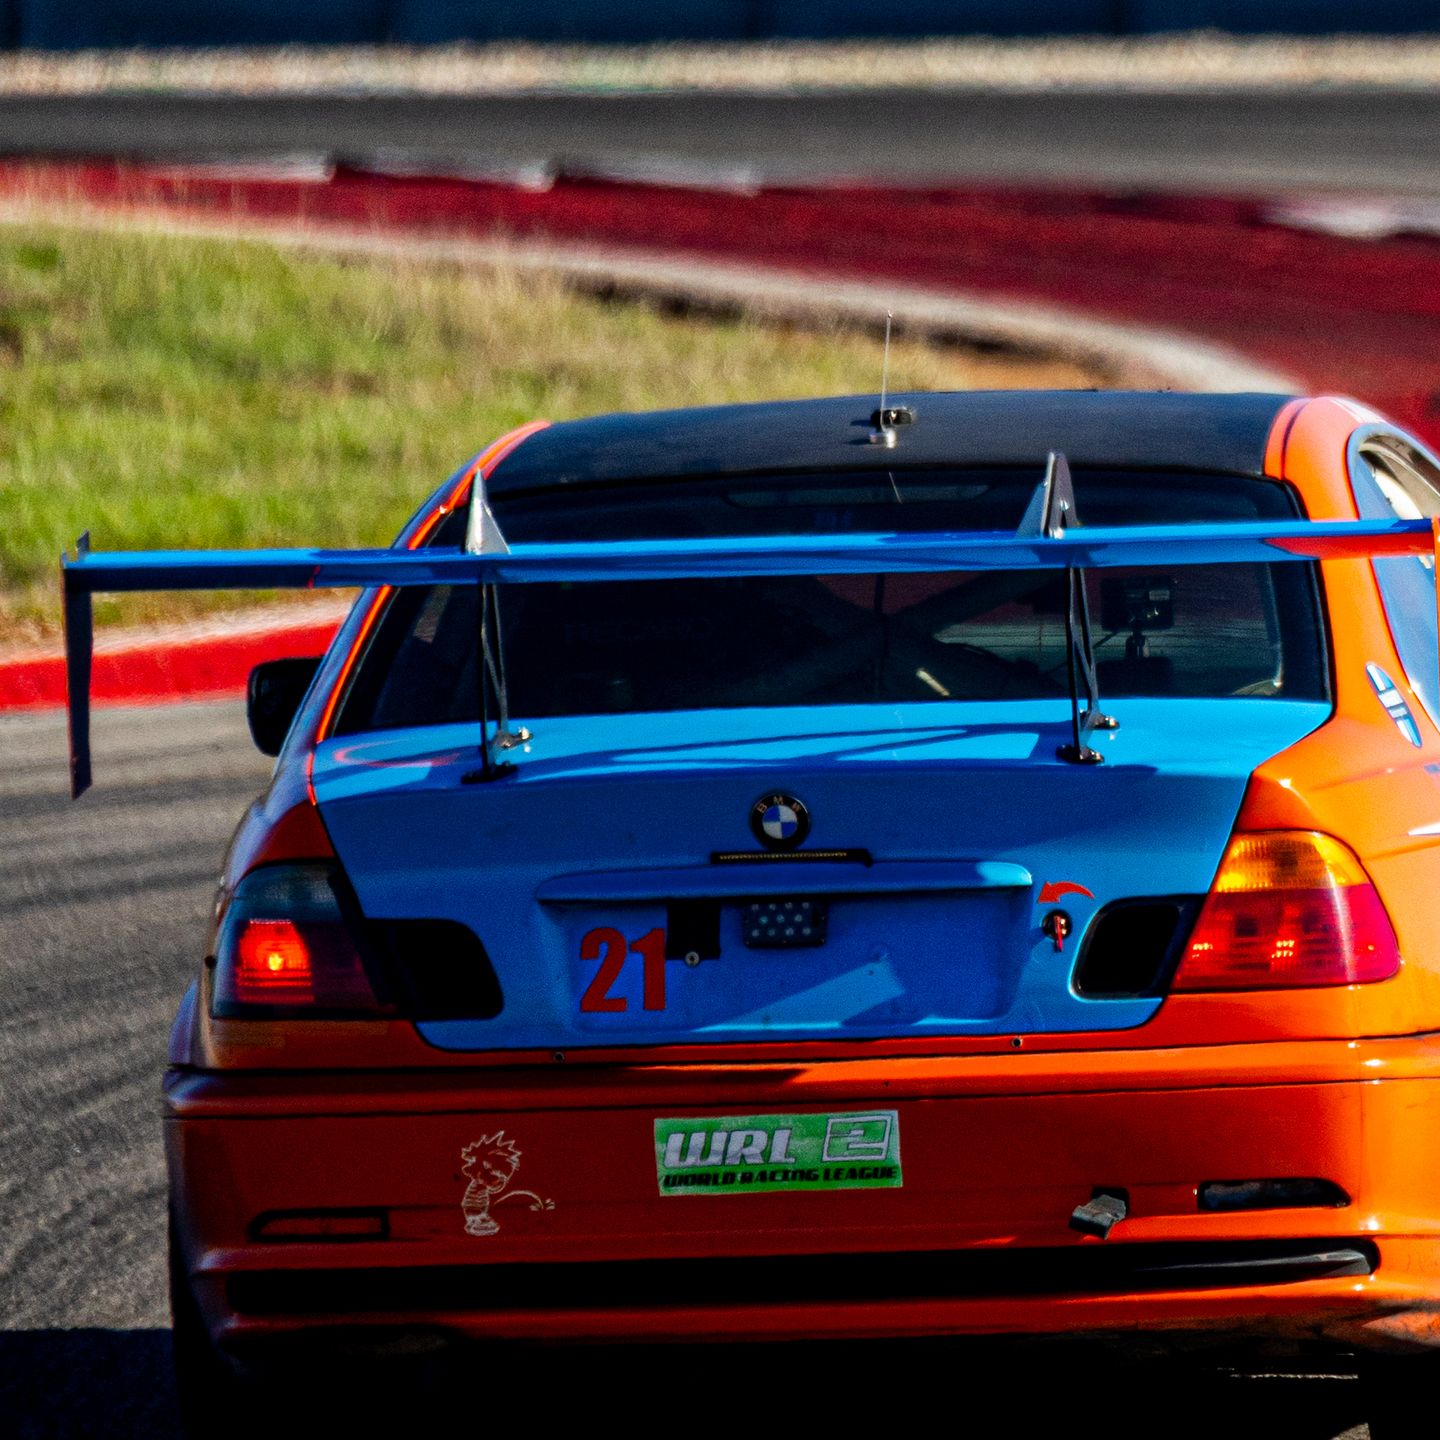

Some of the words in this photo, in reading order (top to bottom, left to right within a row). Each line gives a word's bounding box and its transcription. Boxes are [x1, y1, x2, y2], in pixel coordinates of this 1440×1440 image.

[757, 795, 802, 814] BMW
[581, 927, 666, 1013] 21
[662, 1127, 796, 1168] WRL
[662, 1171, 736, 1188] WORLD
[739, 1168, 820, 1185] RACING
[822, 1165, 898, 1182] LEAGUE
